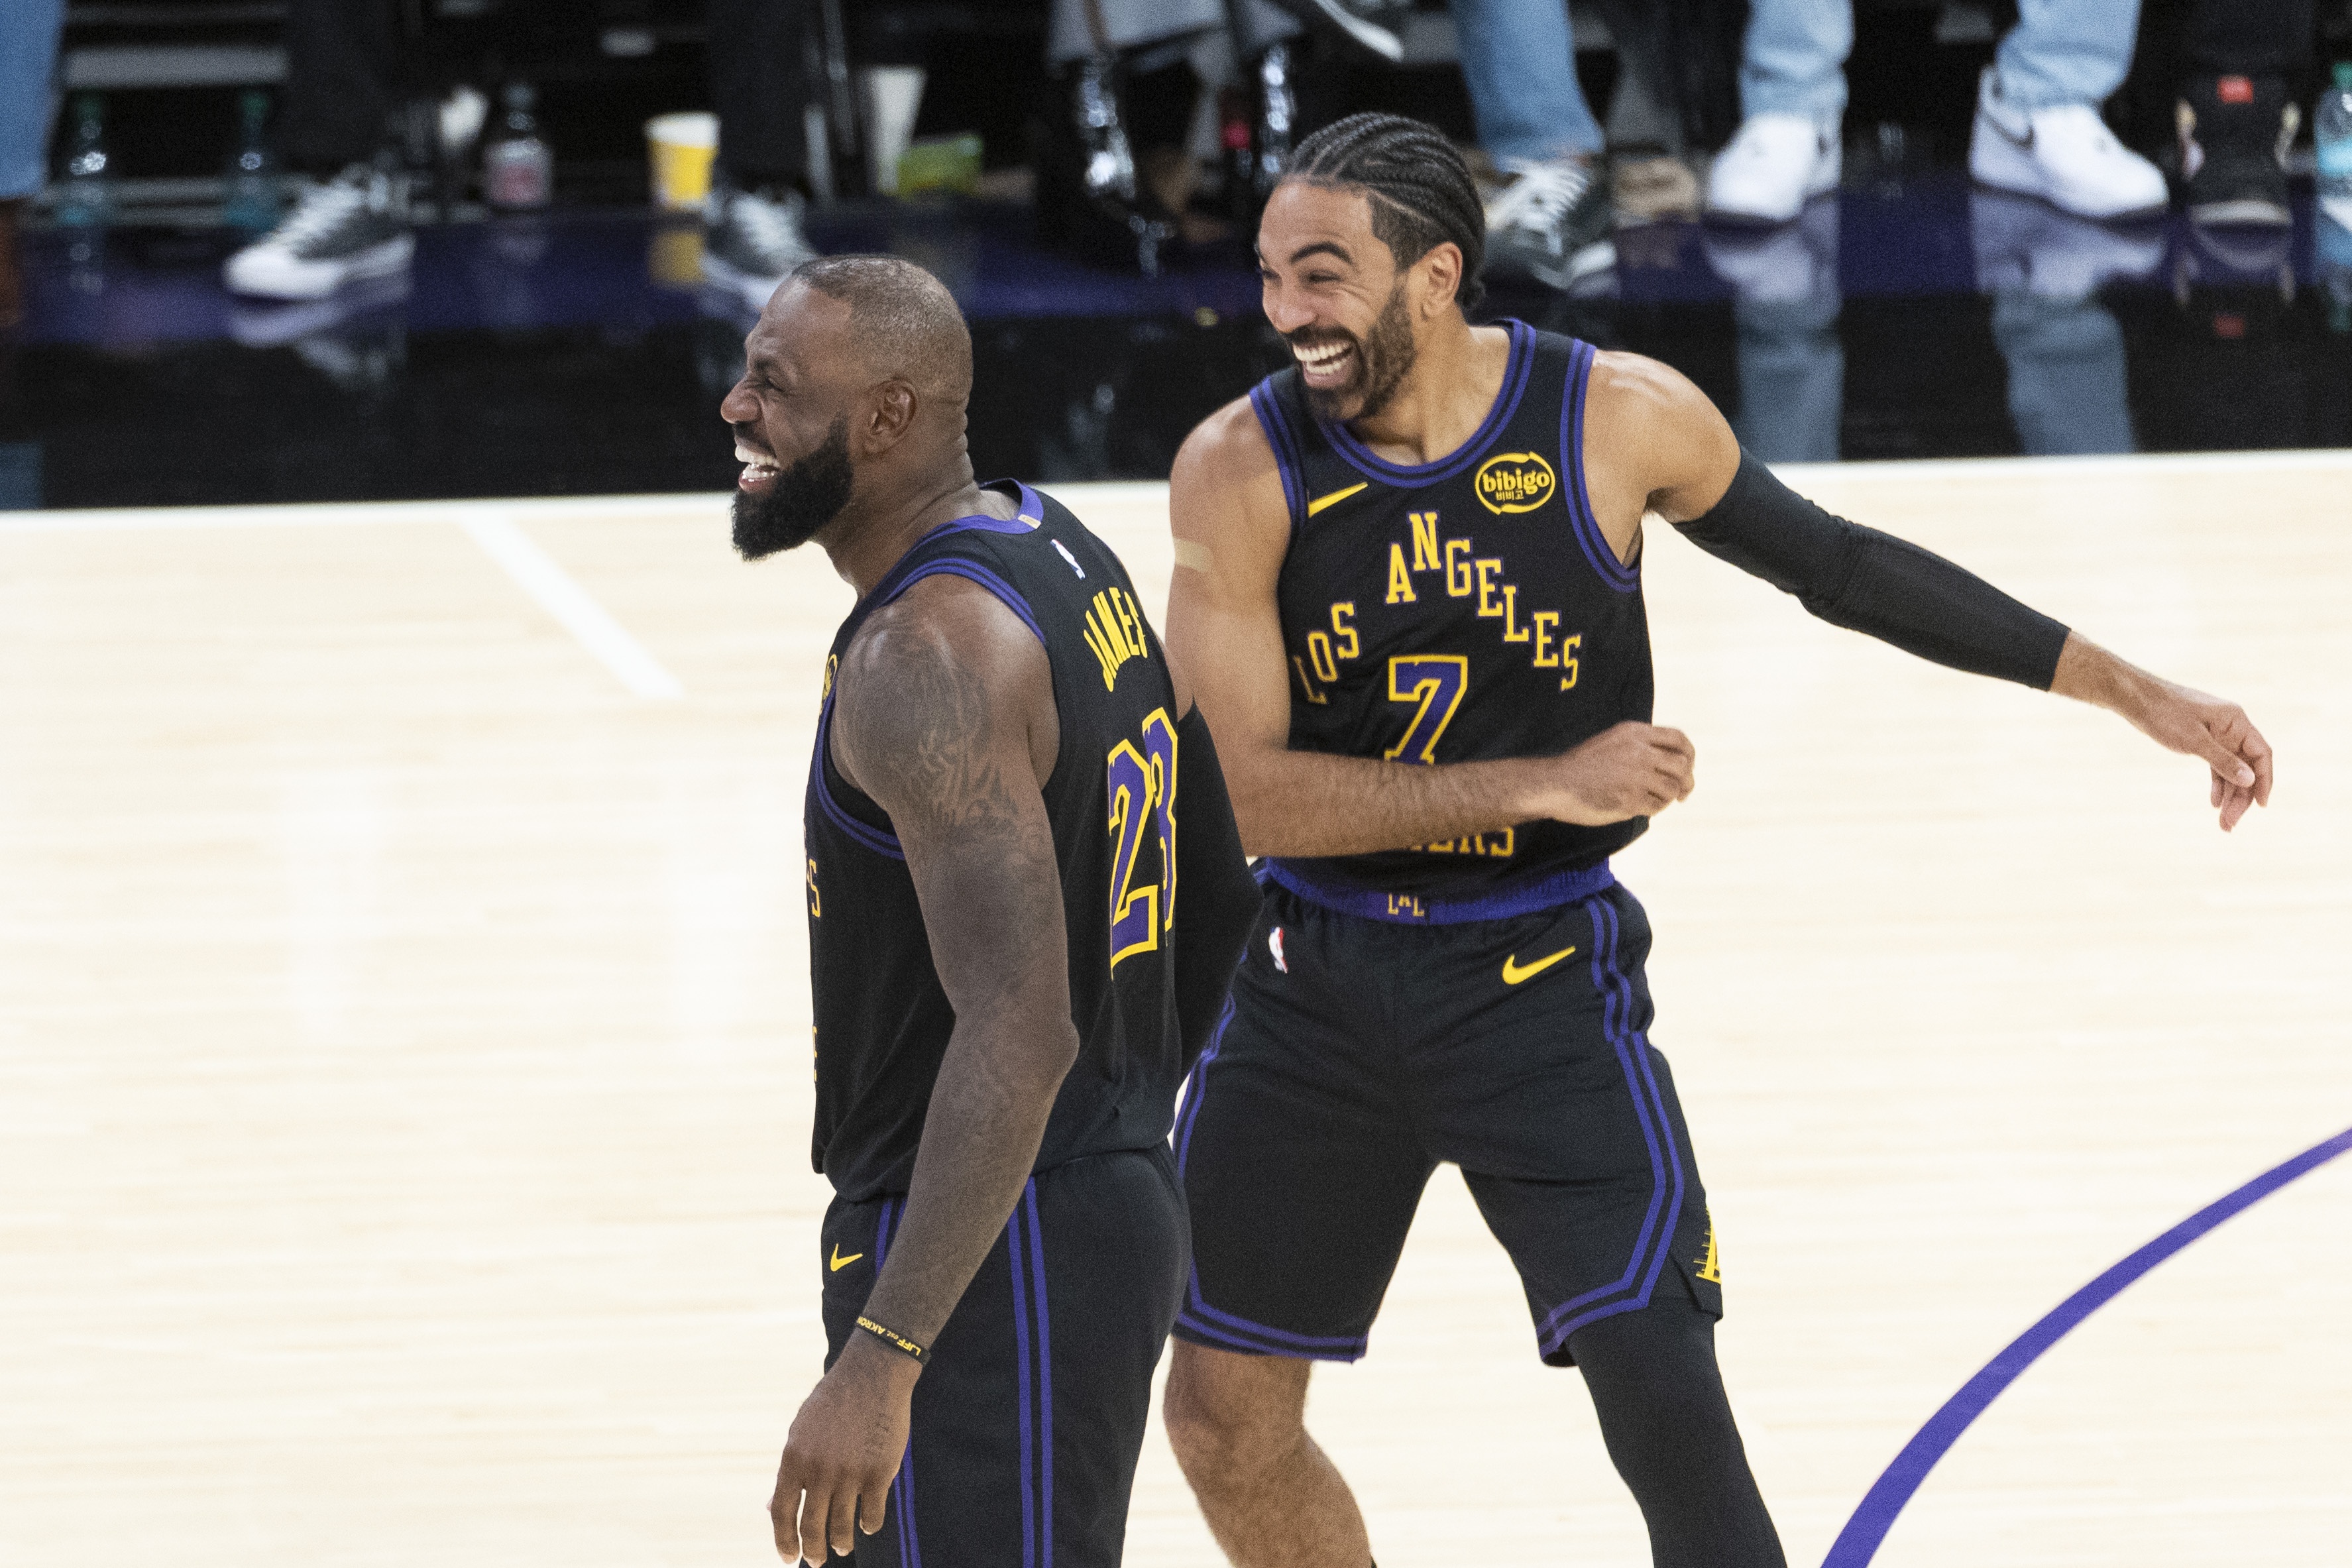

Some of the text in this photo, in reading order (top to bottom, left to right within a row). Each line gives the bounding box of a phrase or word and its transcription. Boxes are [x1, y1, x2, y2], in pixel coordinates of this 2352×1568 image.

[1483, 467, 1550, 494] bibigo
[1496, 490, 1524, 502] 비비고
[1293, 510, 1582, 704] LOS ANGELES
[1384, 653, 1469, 766] 7
[1107, 706, 1178, 981] 23
